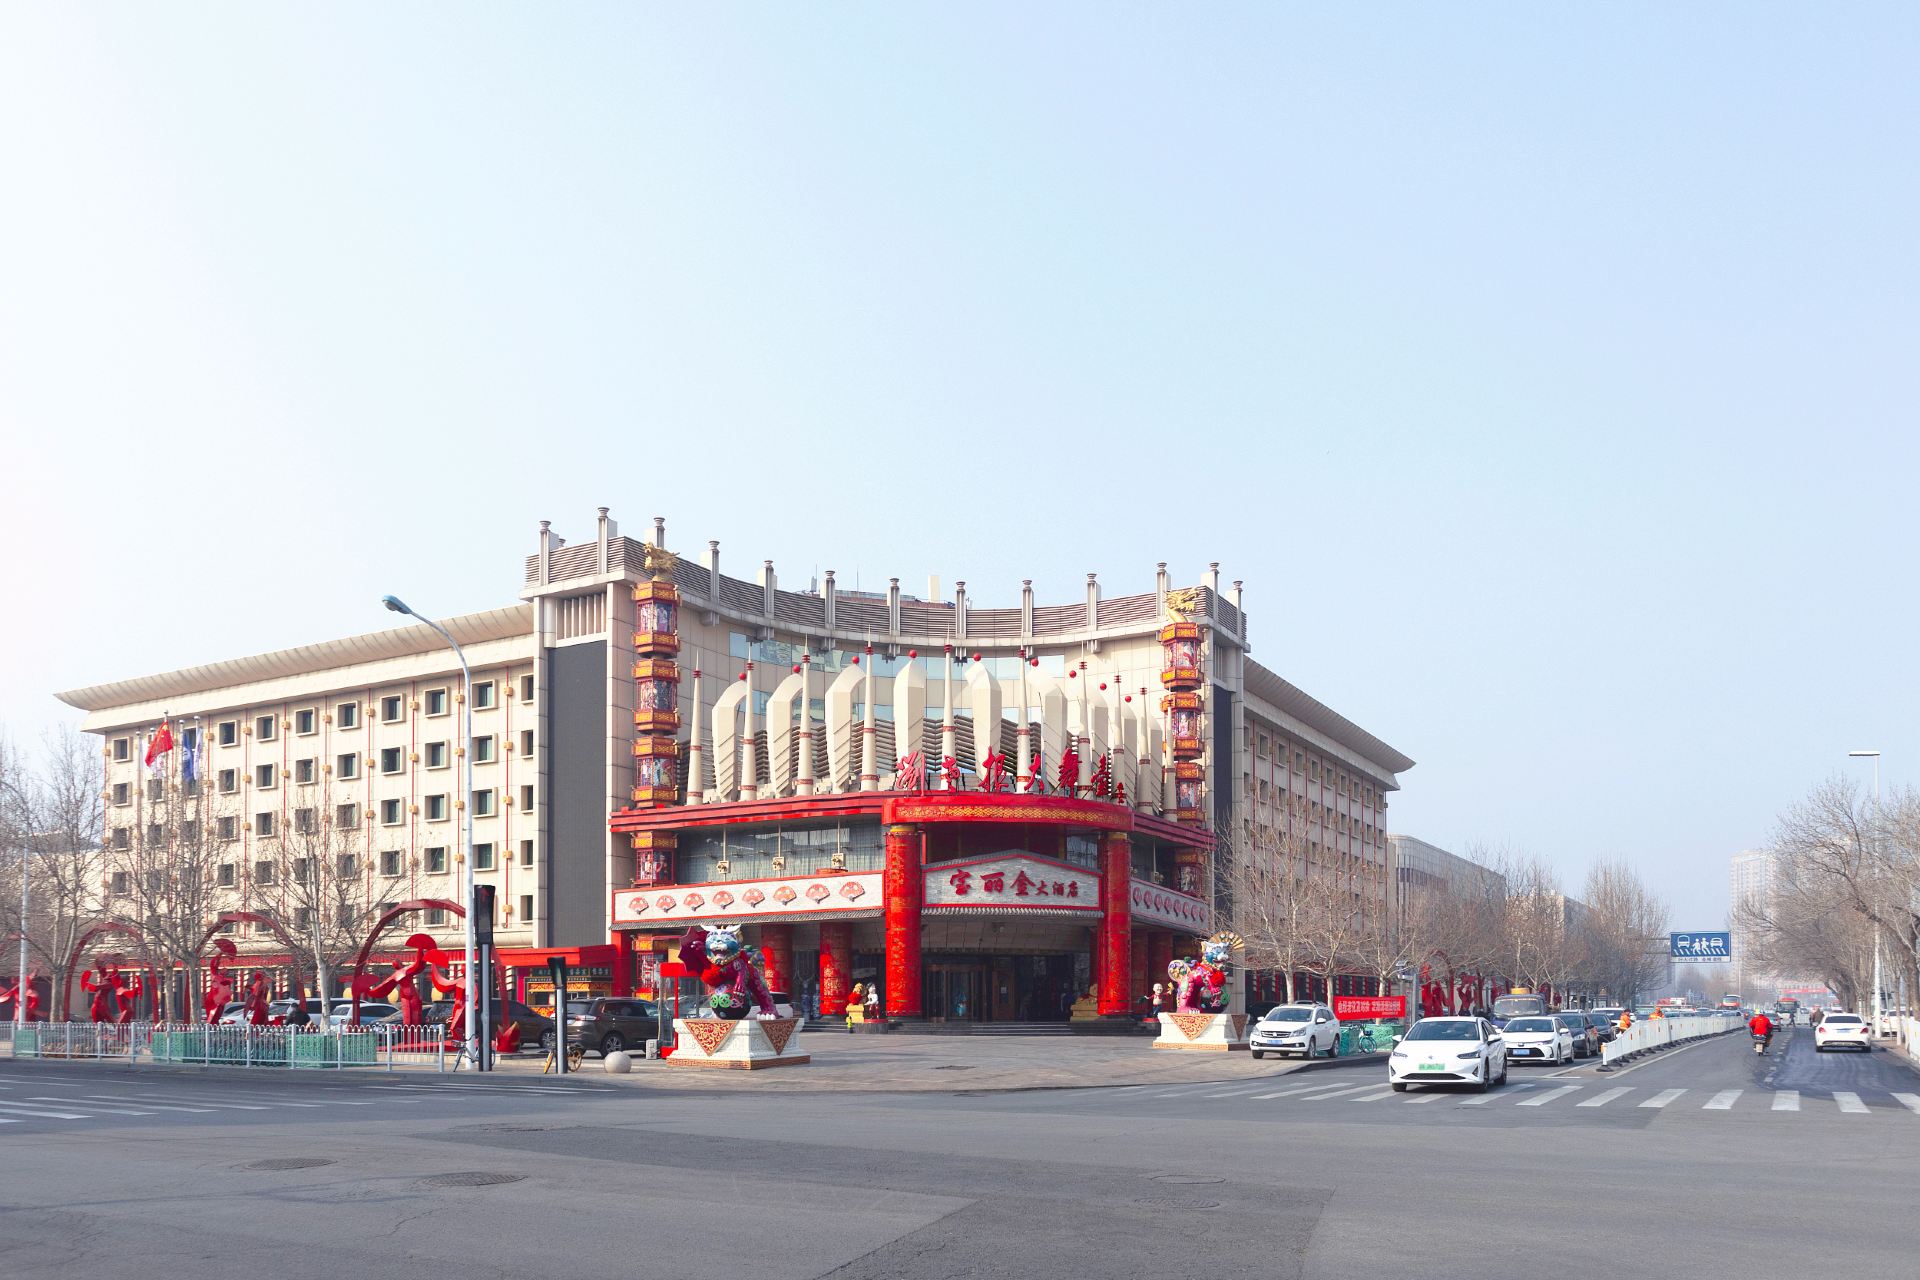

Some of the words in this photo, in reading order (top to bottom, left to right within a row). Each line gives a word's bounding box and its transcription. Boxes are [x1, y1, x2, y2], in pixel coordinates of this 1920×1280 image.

[950, 869, 1079, 898] 宝丽金大酒店
